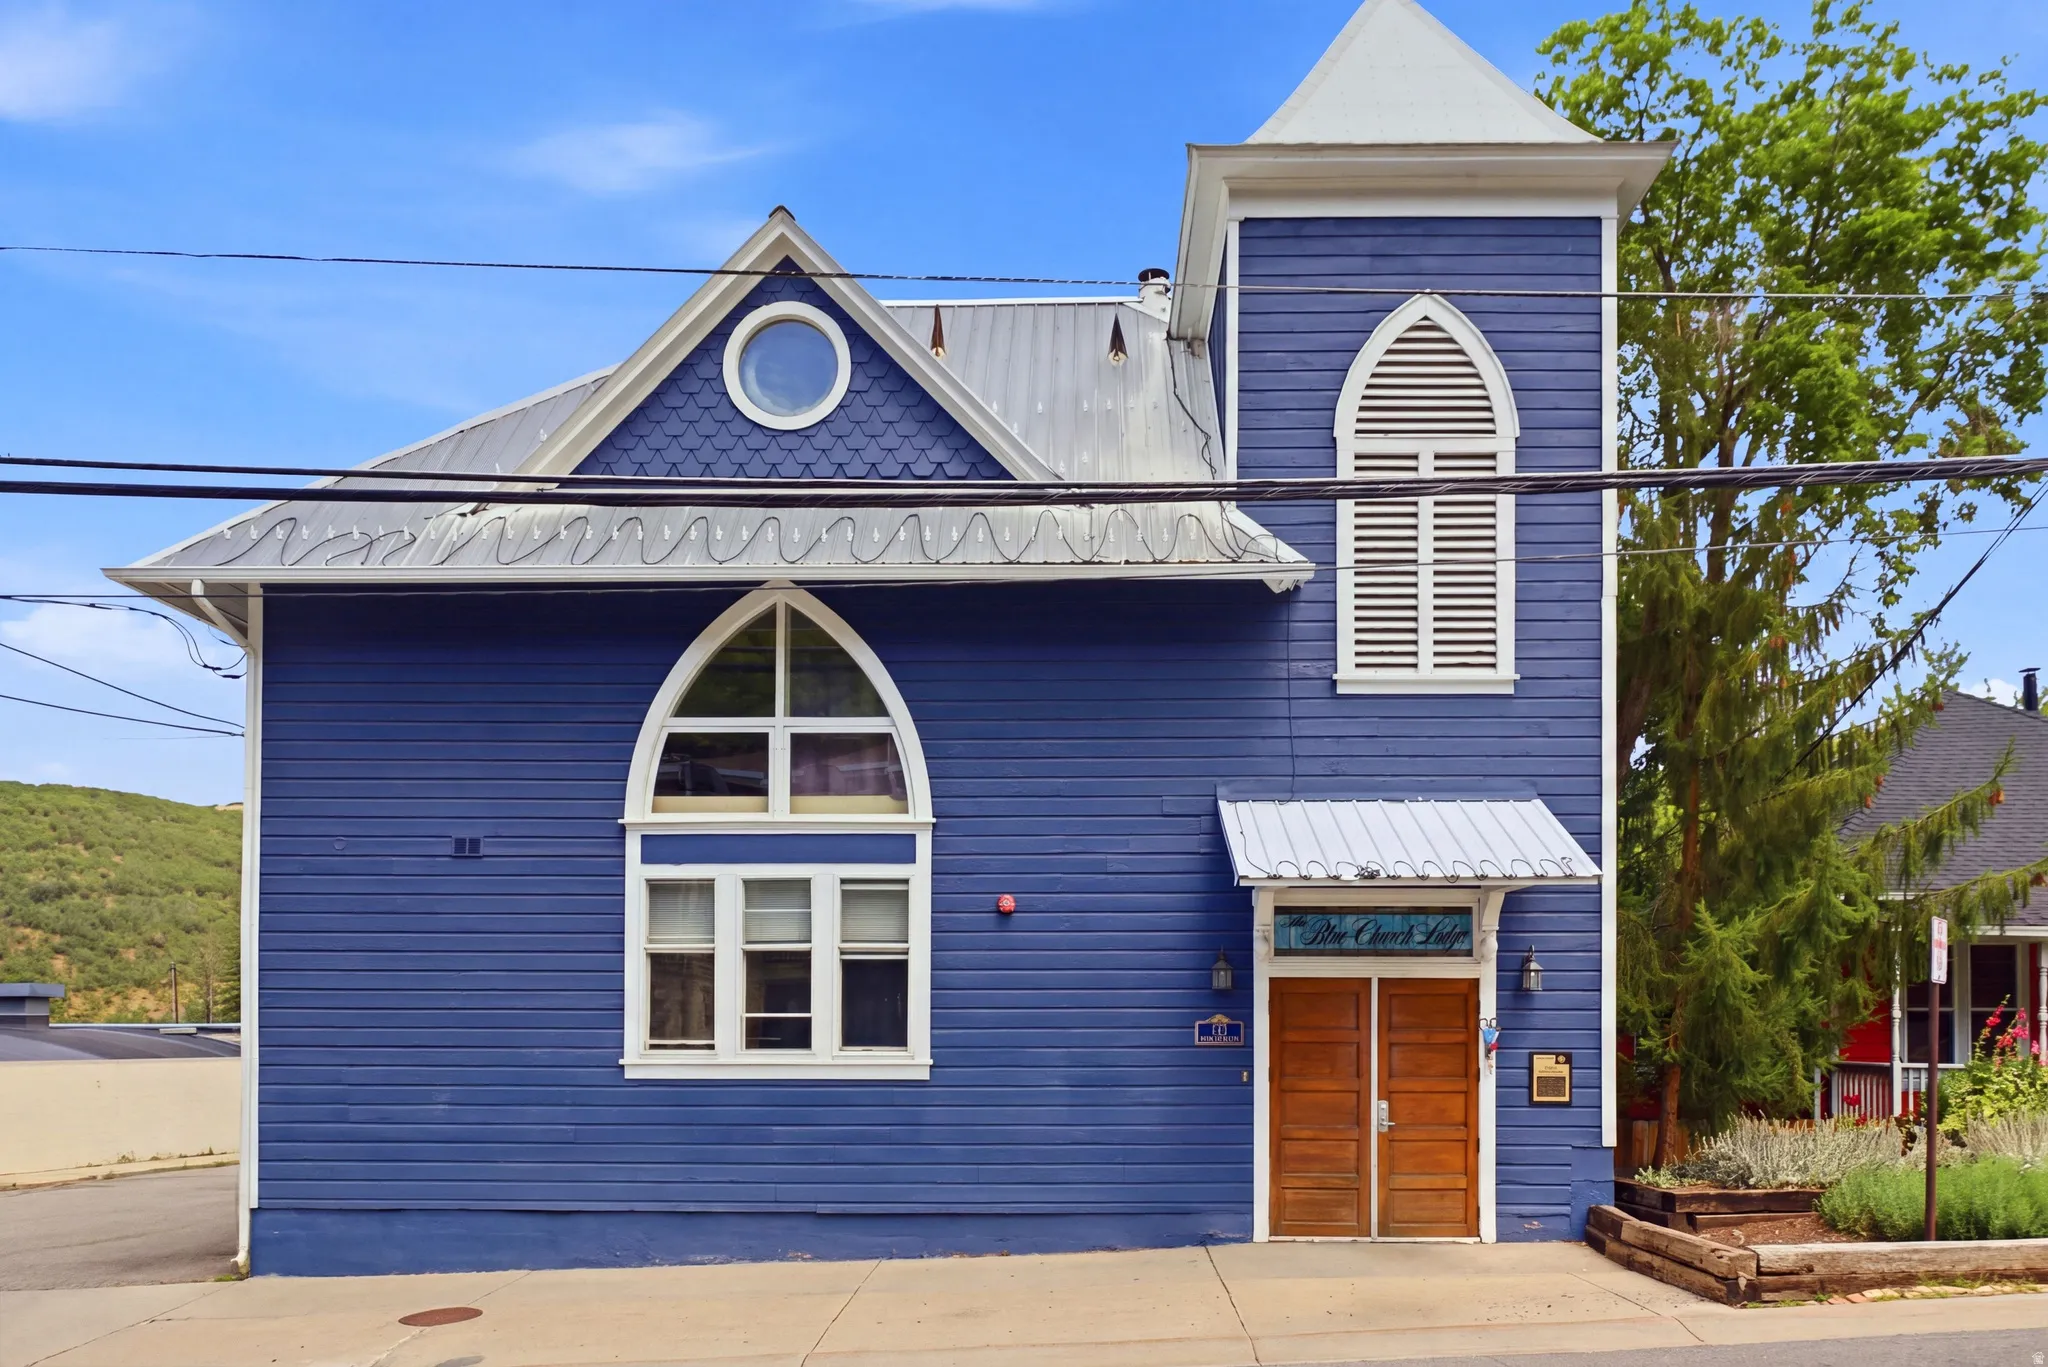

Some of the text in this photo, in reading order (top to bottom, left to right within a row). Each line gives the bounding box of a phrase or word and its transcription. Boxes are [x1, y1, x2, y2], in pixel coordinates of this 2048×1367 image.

[1300, 916, 1349, 946] Blue
[1352, 917, 1415, 946] Church
[1414, 916, 1470, 953] Lodge
